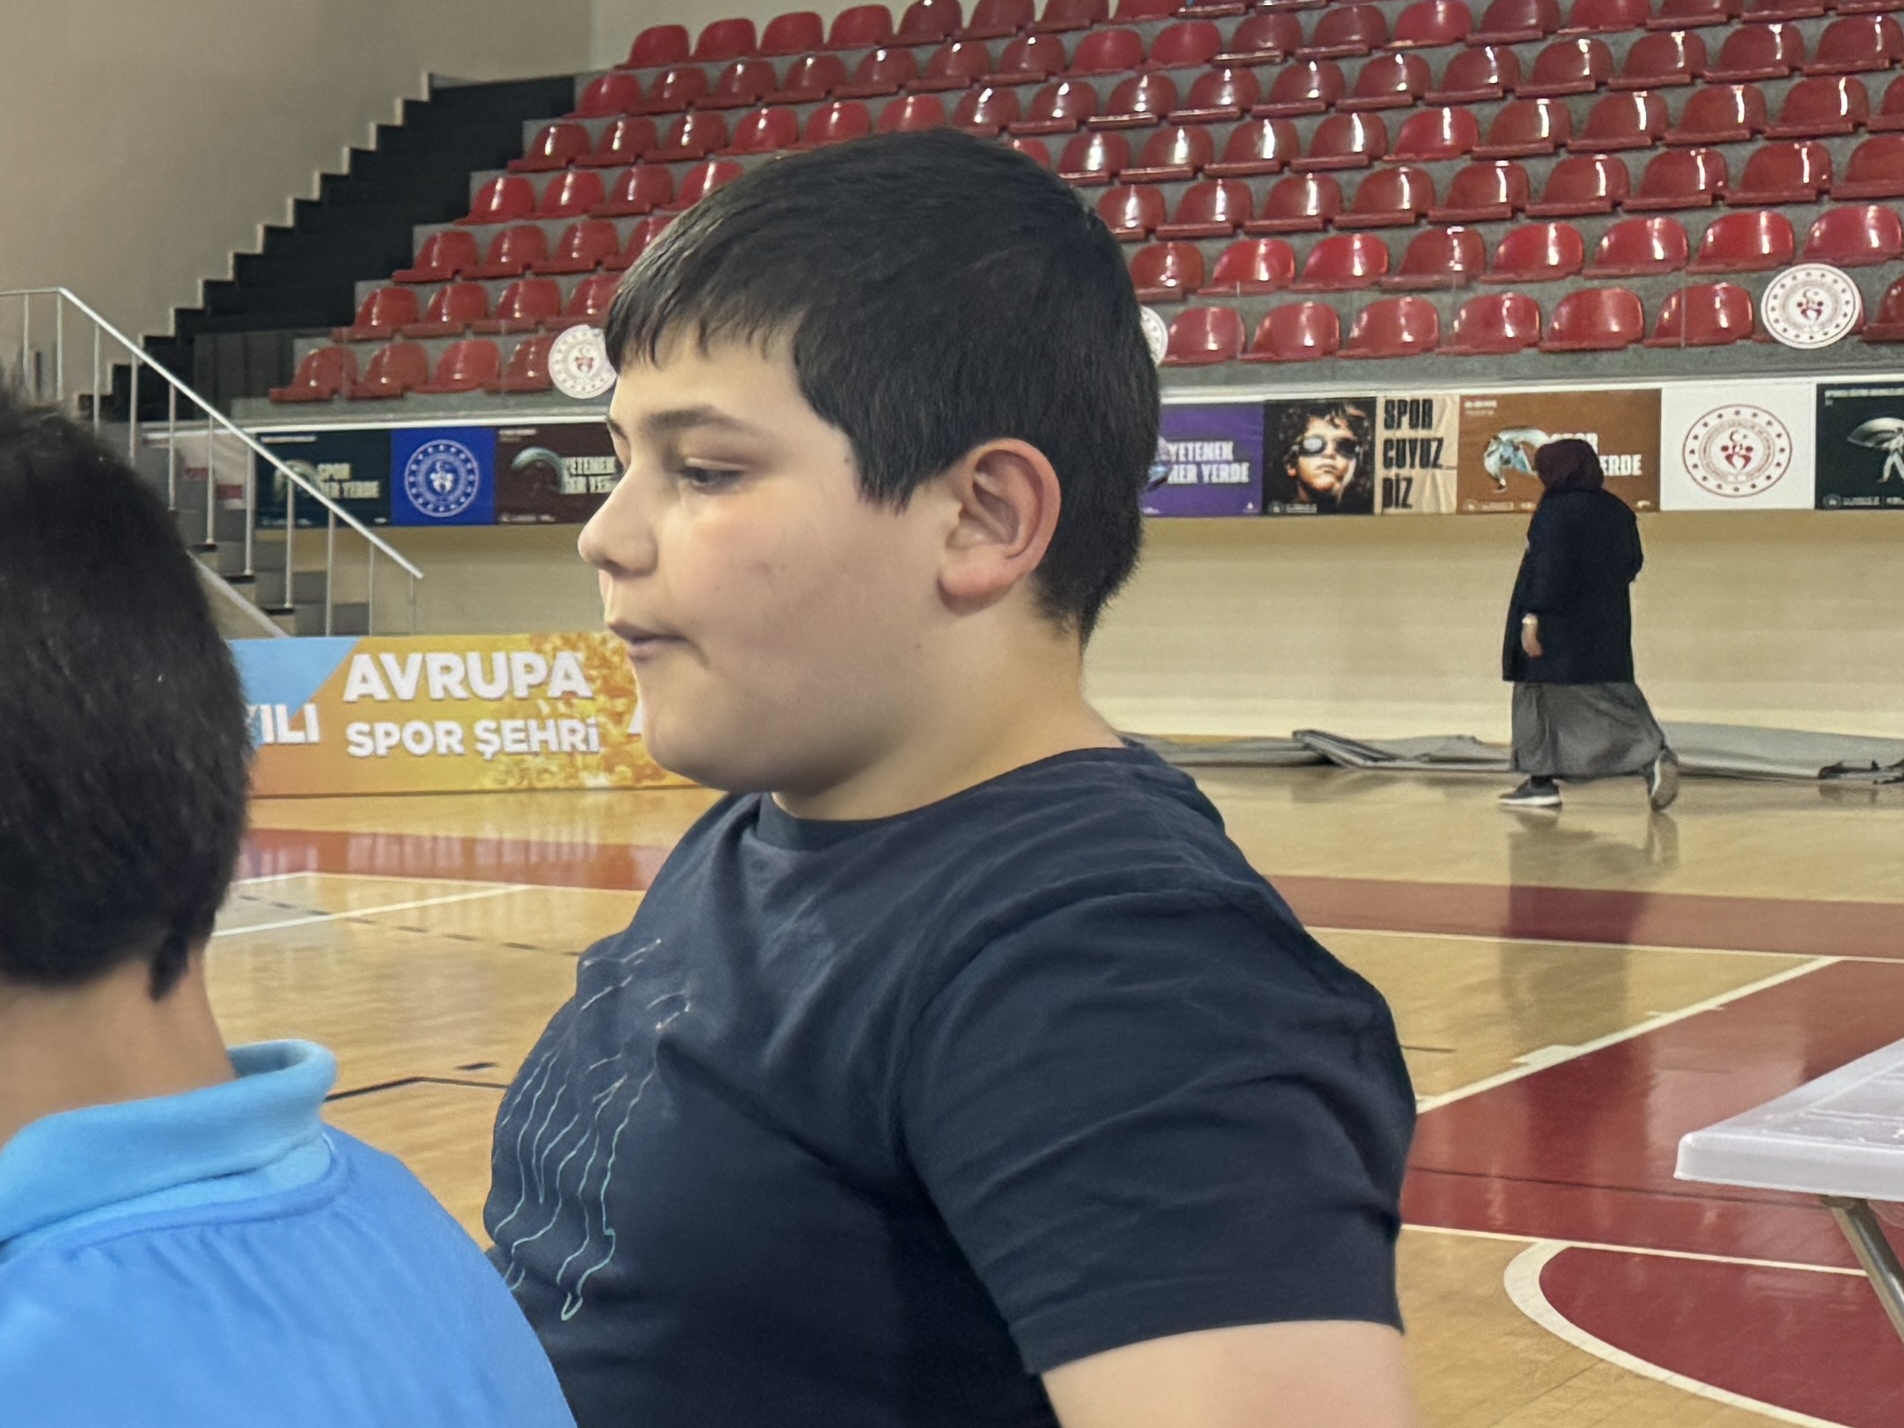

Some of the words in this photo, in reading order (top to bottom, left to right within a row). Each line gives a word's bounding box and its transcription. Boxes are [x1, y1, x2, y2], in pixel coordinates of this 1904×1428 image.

[1599, 454, 1642, 476] ERDE
[343, 652, 592, 702] AVRUPA
[346, 721, 464, 758] SPOR
